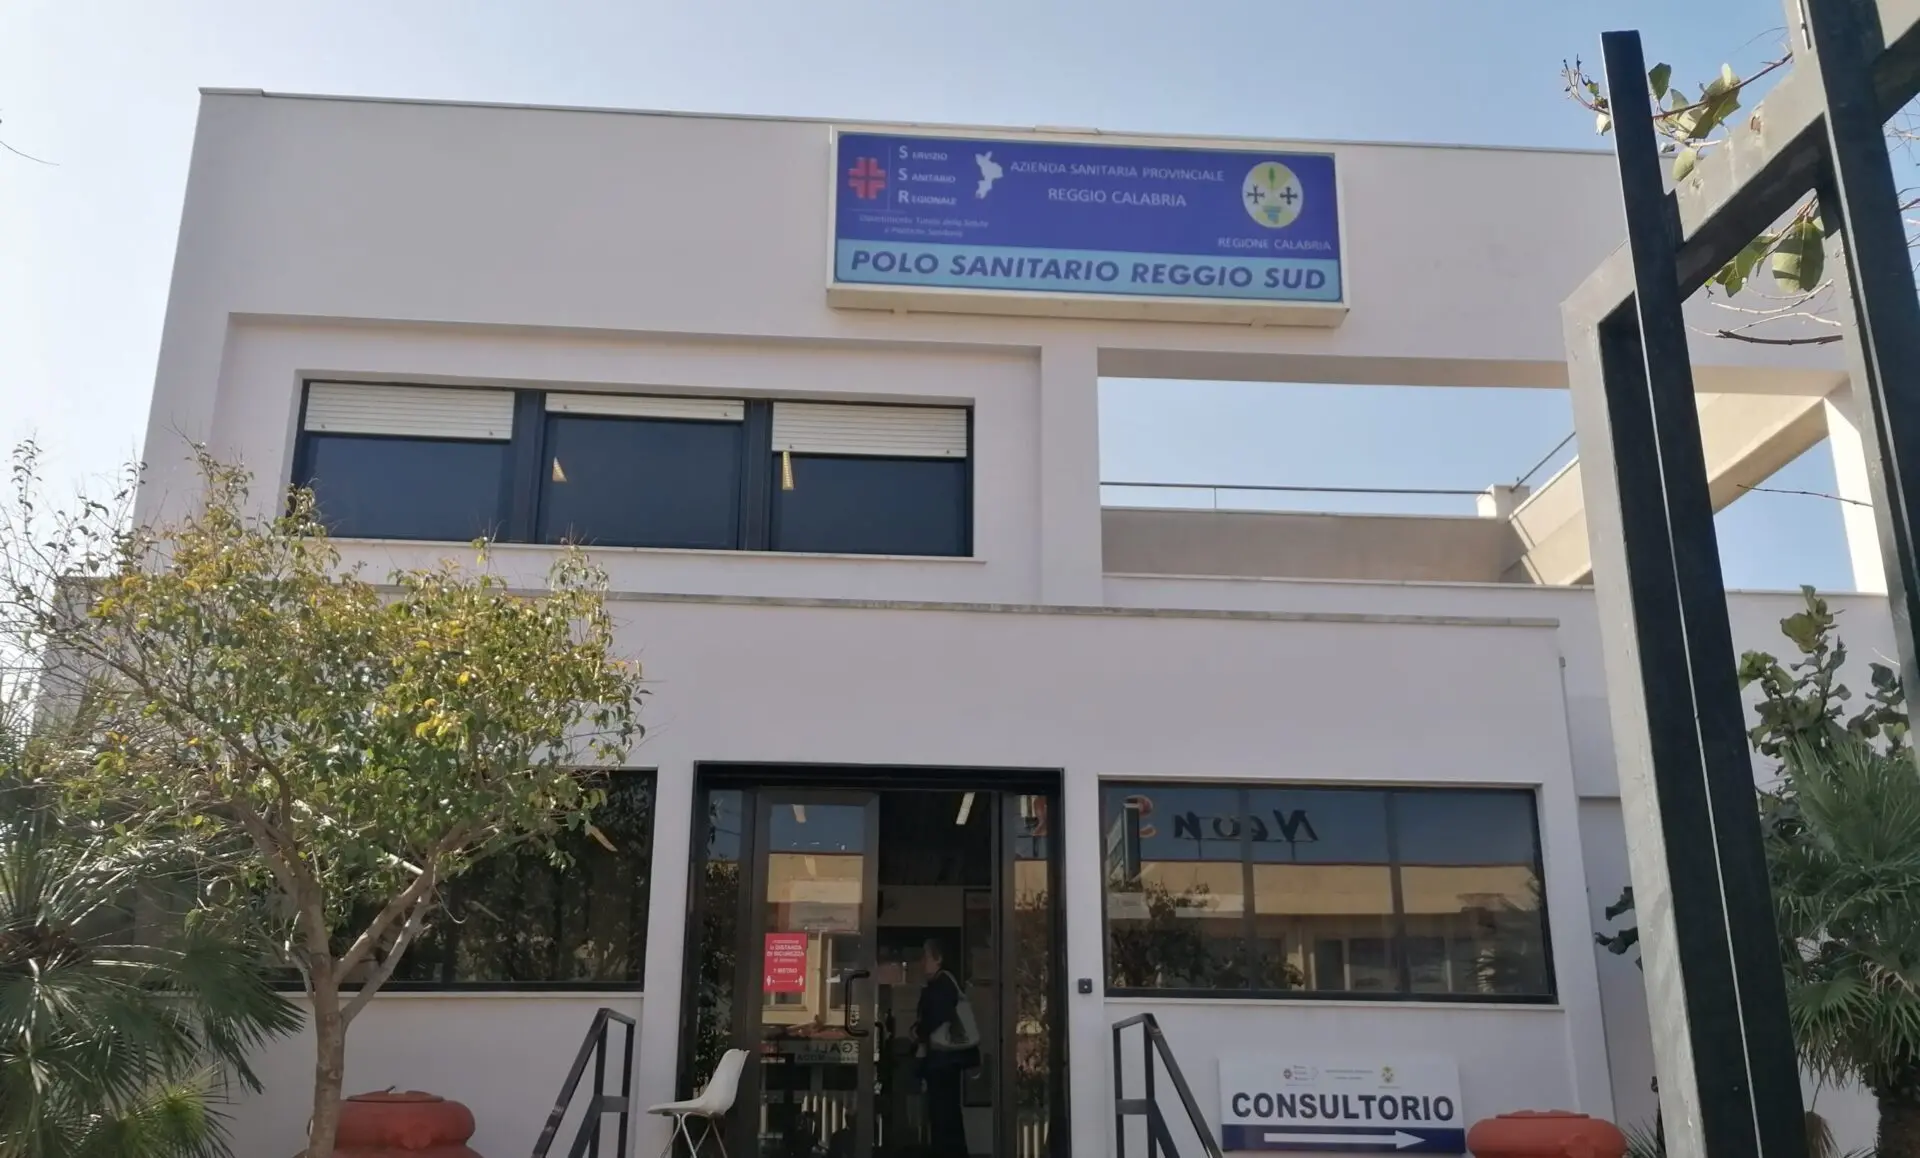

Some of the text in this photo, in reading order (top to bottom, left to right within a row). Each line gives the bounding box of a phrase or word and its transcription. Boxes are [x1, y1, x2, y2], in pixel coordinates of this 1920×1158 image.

[1010, 161, 1225, 182] AZIENDA SANITARIA PROVINCIALE
[1047, 188, 1187, 207] REGGIO CALABRIA
[1217, 237, 1332, 252] REGIONE CALABRIA
[851, 250, 1326, 290] POLO SANITARIO REGGIO SUD
[1231, 1092, 1455, 1121] CONSULTORIO
